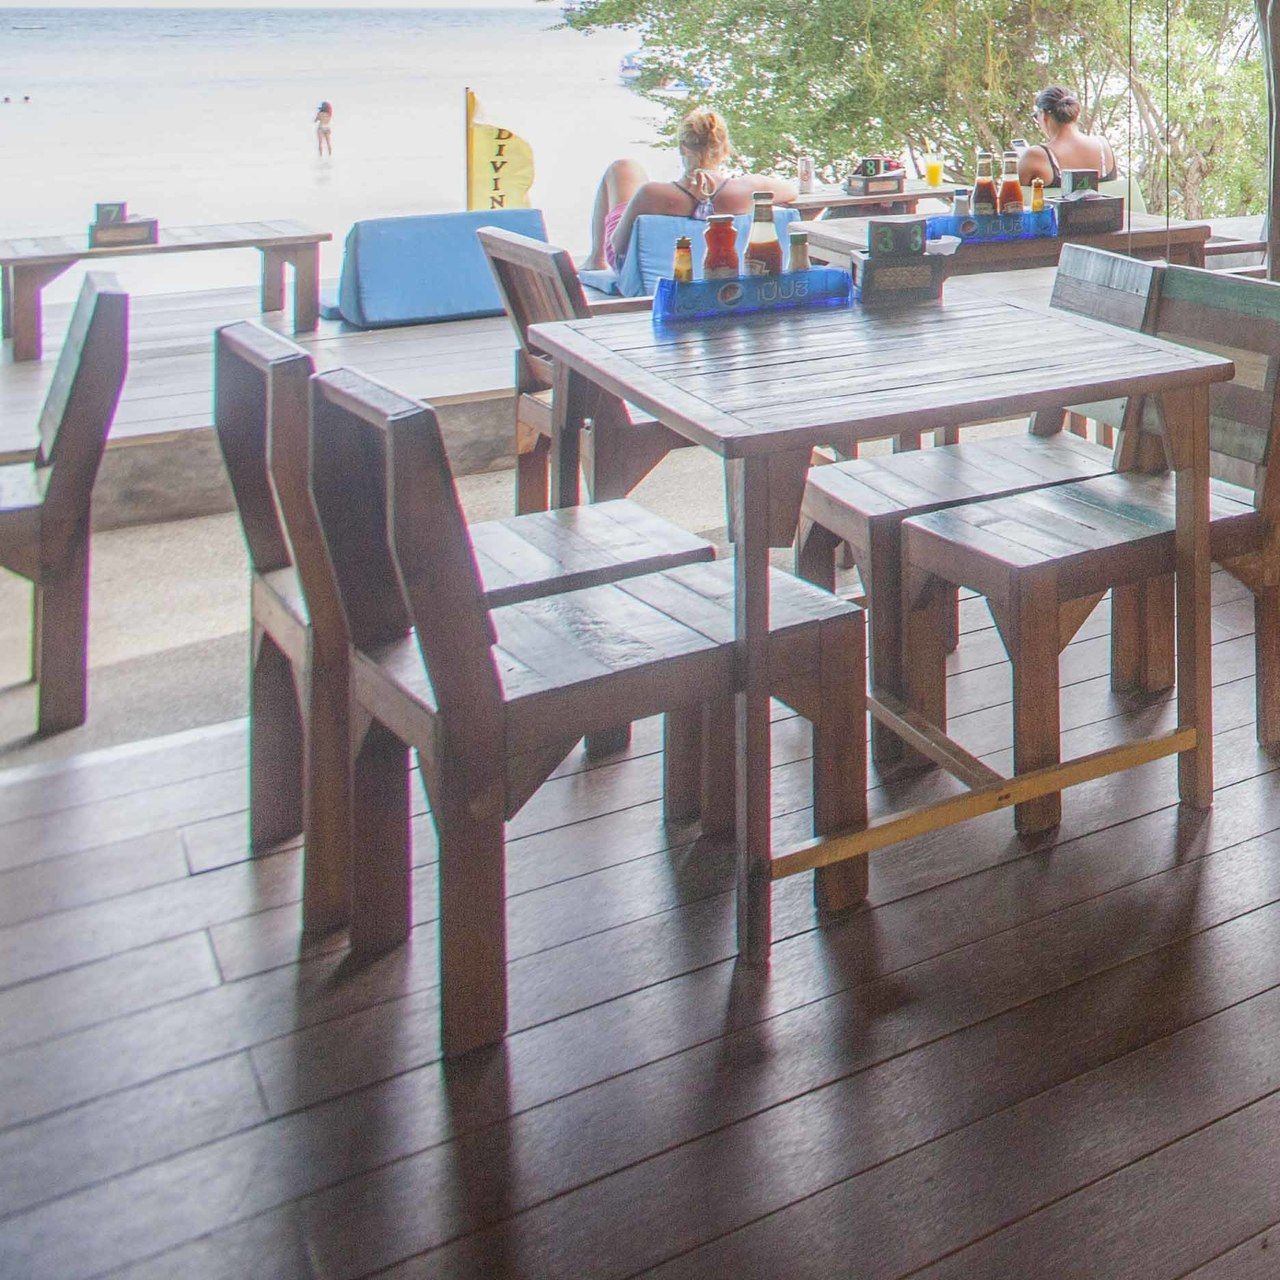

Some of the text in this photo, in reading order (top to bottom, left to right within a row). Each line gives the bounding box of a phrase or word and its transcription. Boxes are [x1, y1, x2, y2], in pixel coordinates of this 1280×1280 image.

[866, 160, 877, 176] 8
[878, 225, 894, 253] 3
[910, 224, 922, 252] 3
